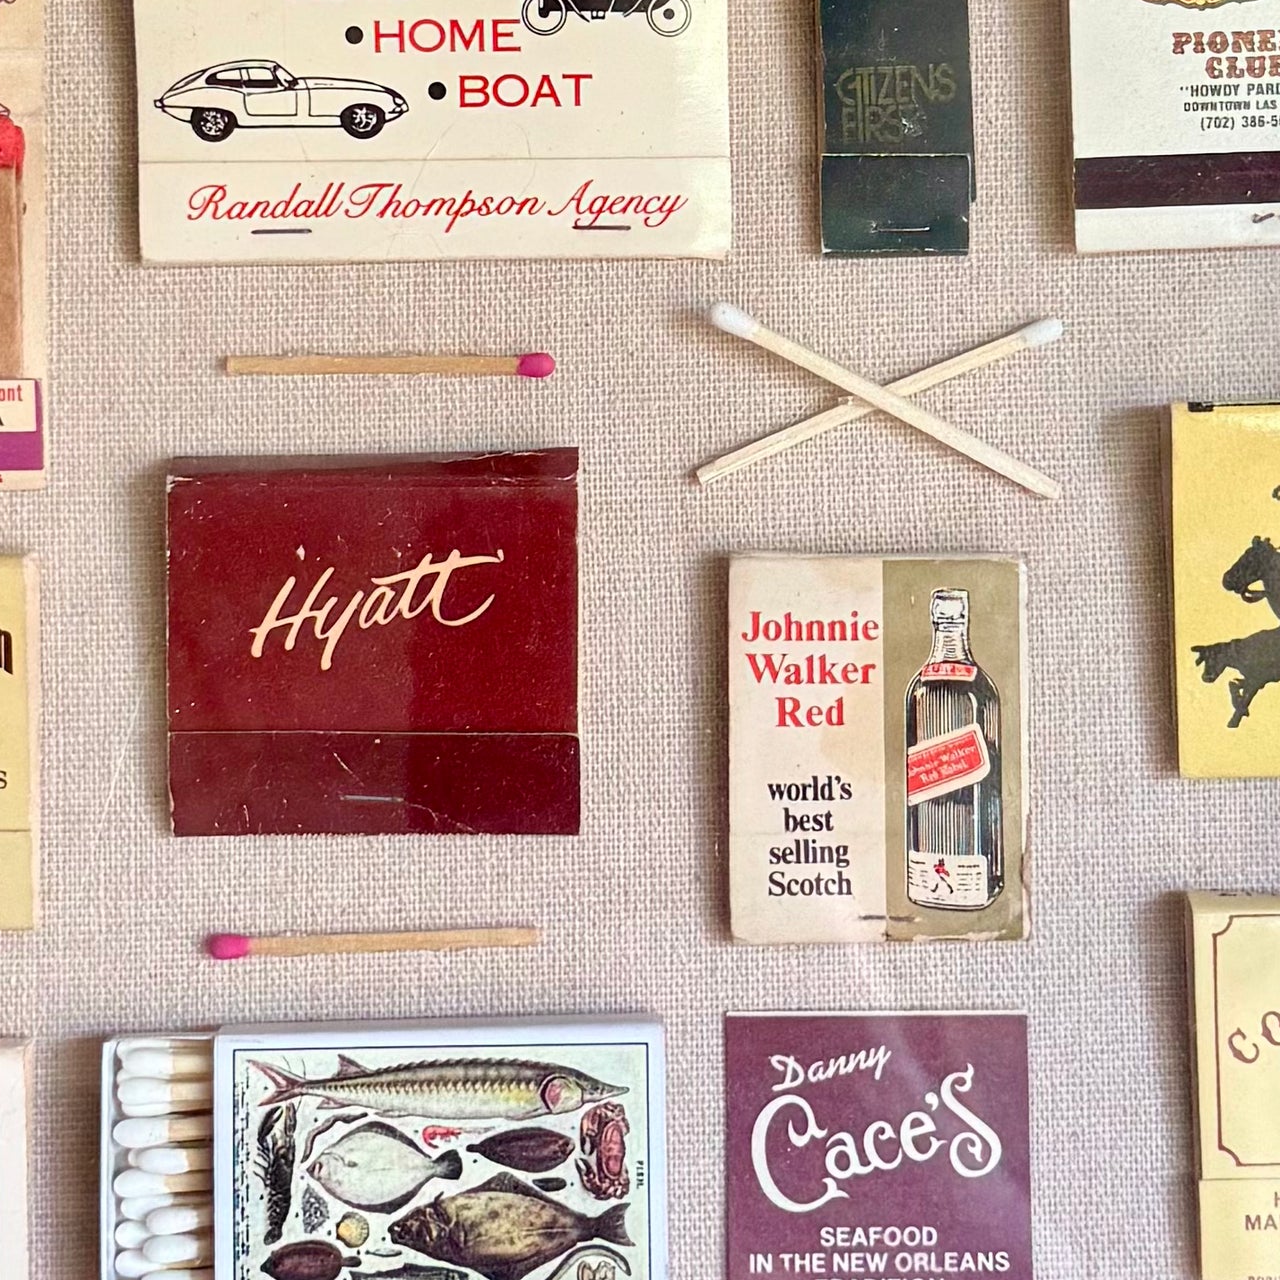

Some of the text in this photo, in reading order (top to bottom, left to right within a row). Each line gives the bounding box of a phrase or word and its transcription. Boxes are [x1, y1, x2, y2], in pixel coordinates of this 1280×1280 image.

[374, 18, 521, 52] HOME
[458, 74, 592, 108] BOAT
[1184, 101, 1250, 112] DOWNTOWN
[1256, 100, 1277, 110] LAS
[1201, 117, 1235, 131] (702)
[188, 178, 688, 234] Randall Thompson Agency
[249, 549, 504, 670] Hyatt
[742, 611, 879, 642] Johnnie
[746, 653, 876, 685] Walker
[776, 697, 845, 728] Red
[768, 776, 852, 802] world's
[784, 807, 834, 832] best
[769, 839, 850, 867] selling
[768, 871, 853, 897] Scotch
[769, 1045, 891, 1092] Danny
[820, 1226, 937, 1247] SEAFOOD
[749, 1252, 1010, 1273] IN THE NEW ORLEANS
